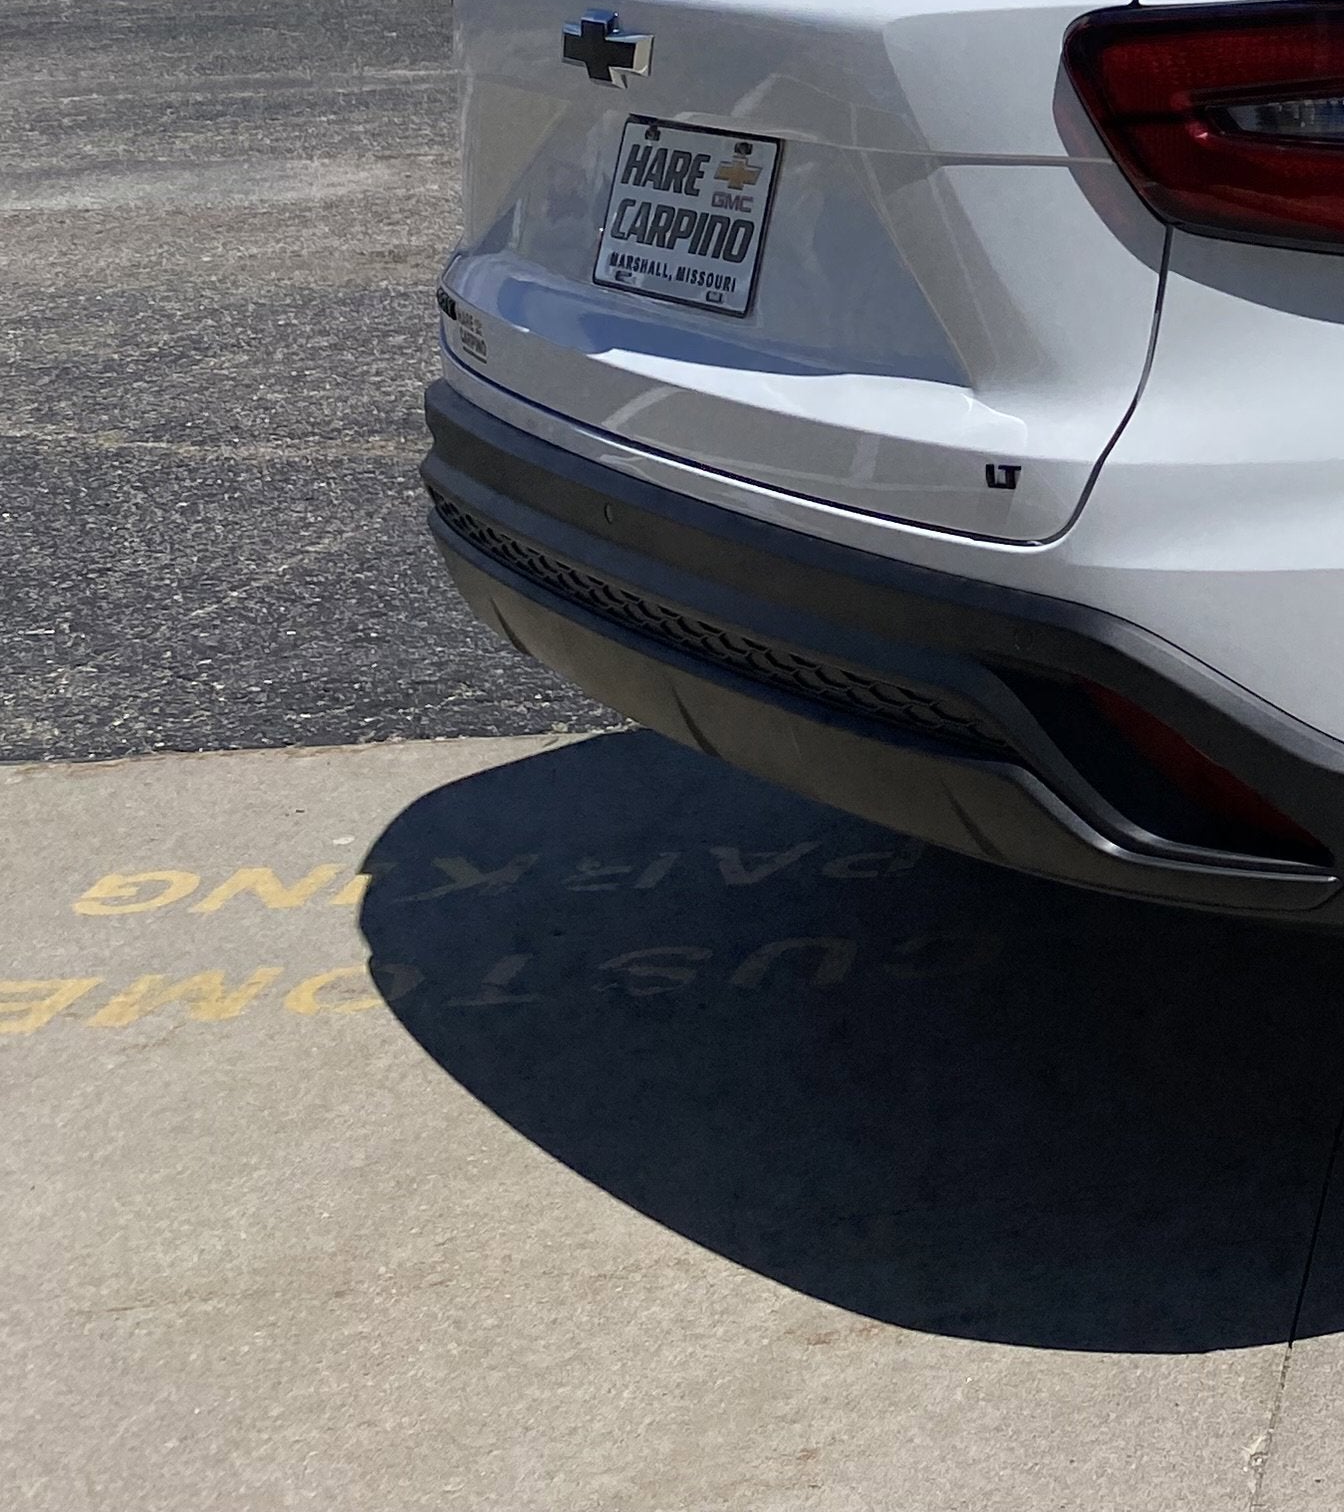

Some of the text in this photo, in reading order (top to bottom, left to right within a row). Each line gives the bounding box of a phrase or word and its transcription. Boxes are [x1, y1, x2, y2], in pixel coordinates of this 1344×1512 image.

[620, 143, 711, 197] HARE
[711, 191, 753, 213] GMC
[610, 197, 755, 264] CARPINO
[675, 265, 737, 293] MISSOURI
[986, 463, 1022, 490] LT
